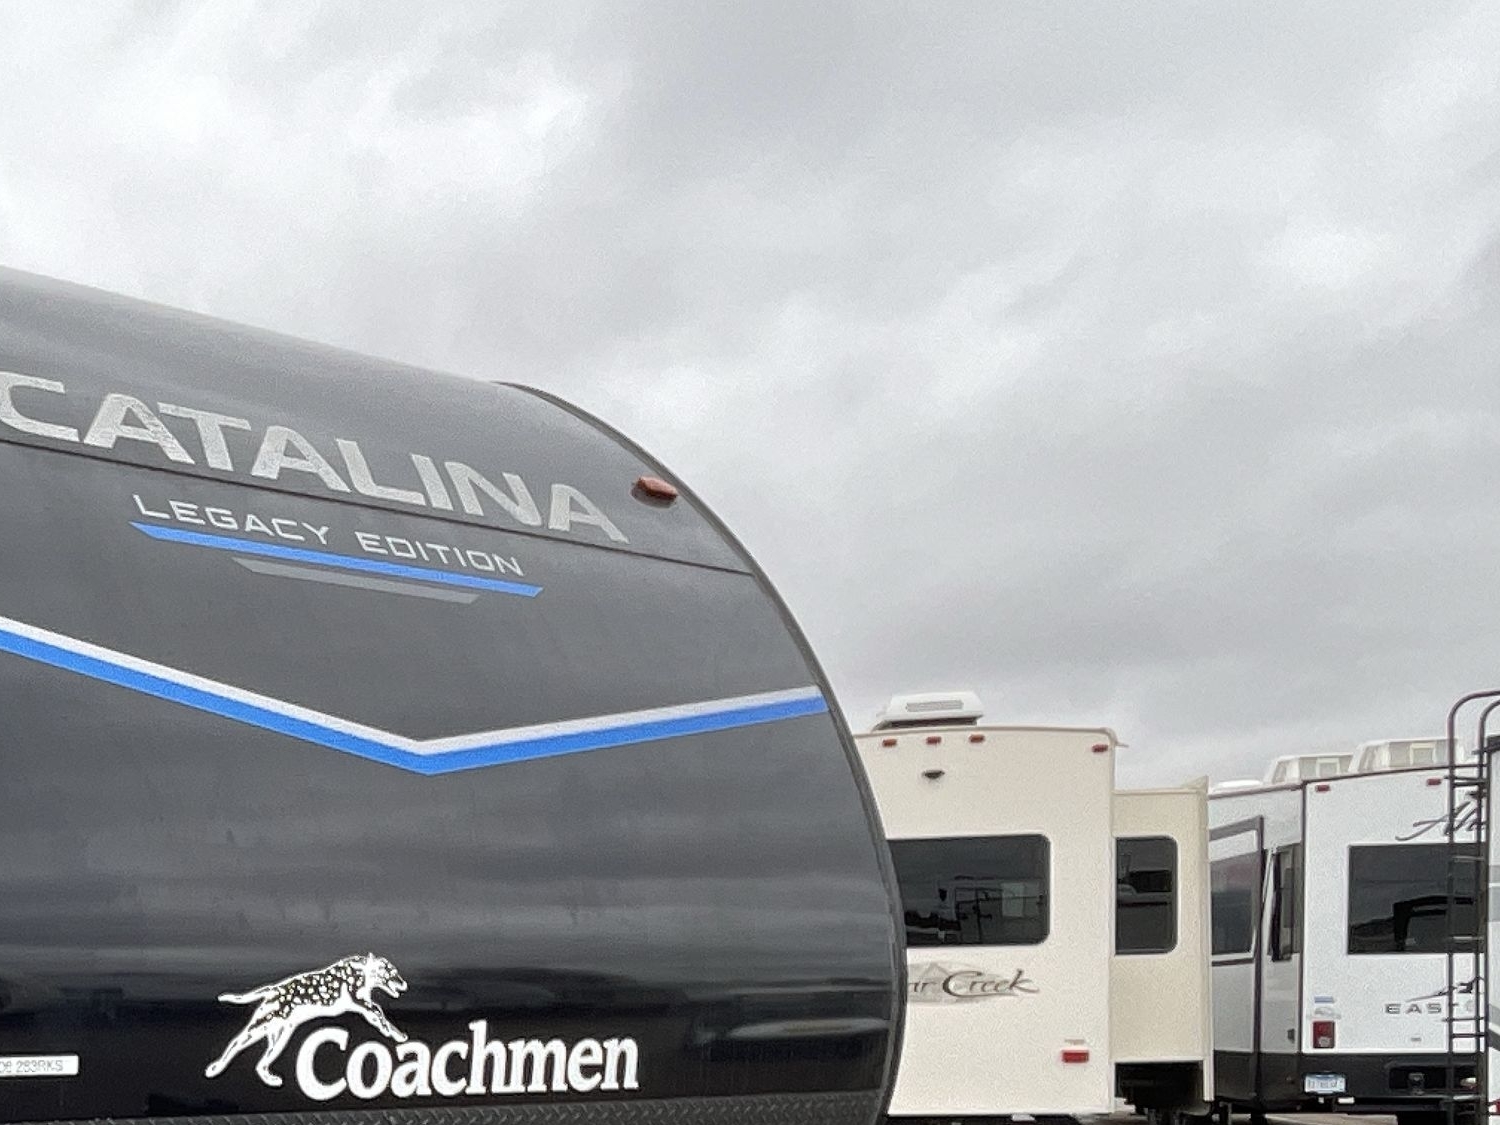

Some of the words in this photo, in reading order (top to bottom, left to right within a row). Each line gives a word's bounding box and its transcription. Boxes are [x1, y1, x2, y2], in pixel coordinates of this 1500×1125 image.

[132, 494, 329, 545] LEGACY
[355, 531, 524, 576] EDITION
[943, 969, 1040, 998] Creek
[296, 1018, 639, 1101] Coachmen
